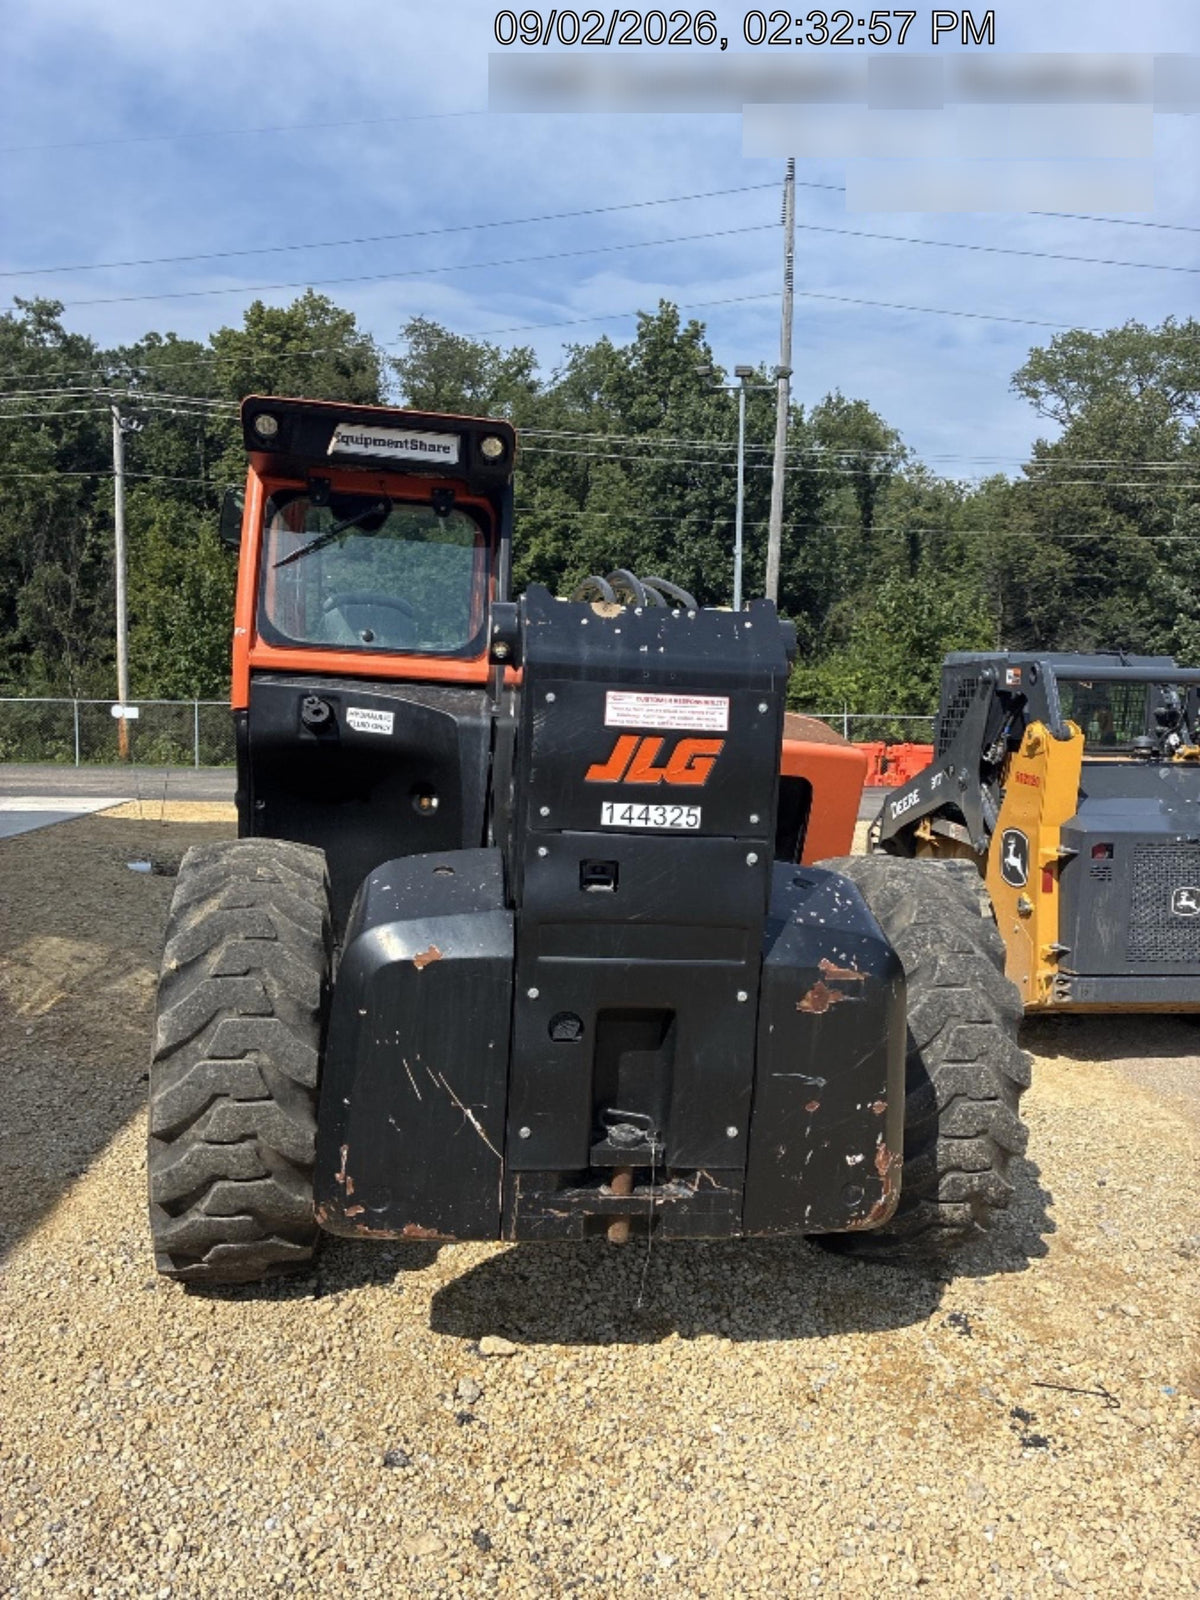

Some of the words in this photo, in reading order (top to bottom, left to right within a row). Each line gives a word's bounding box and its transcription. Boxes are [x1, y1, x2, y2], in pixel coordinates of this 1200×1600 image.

[584, 735, 725, 786] JLG
[605, 803, 699, 828] 144325
[890, 788, 920, 820] DEERE
